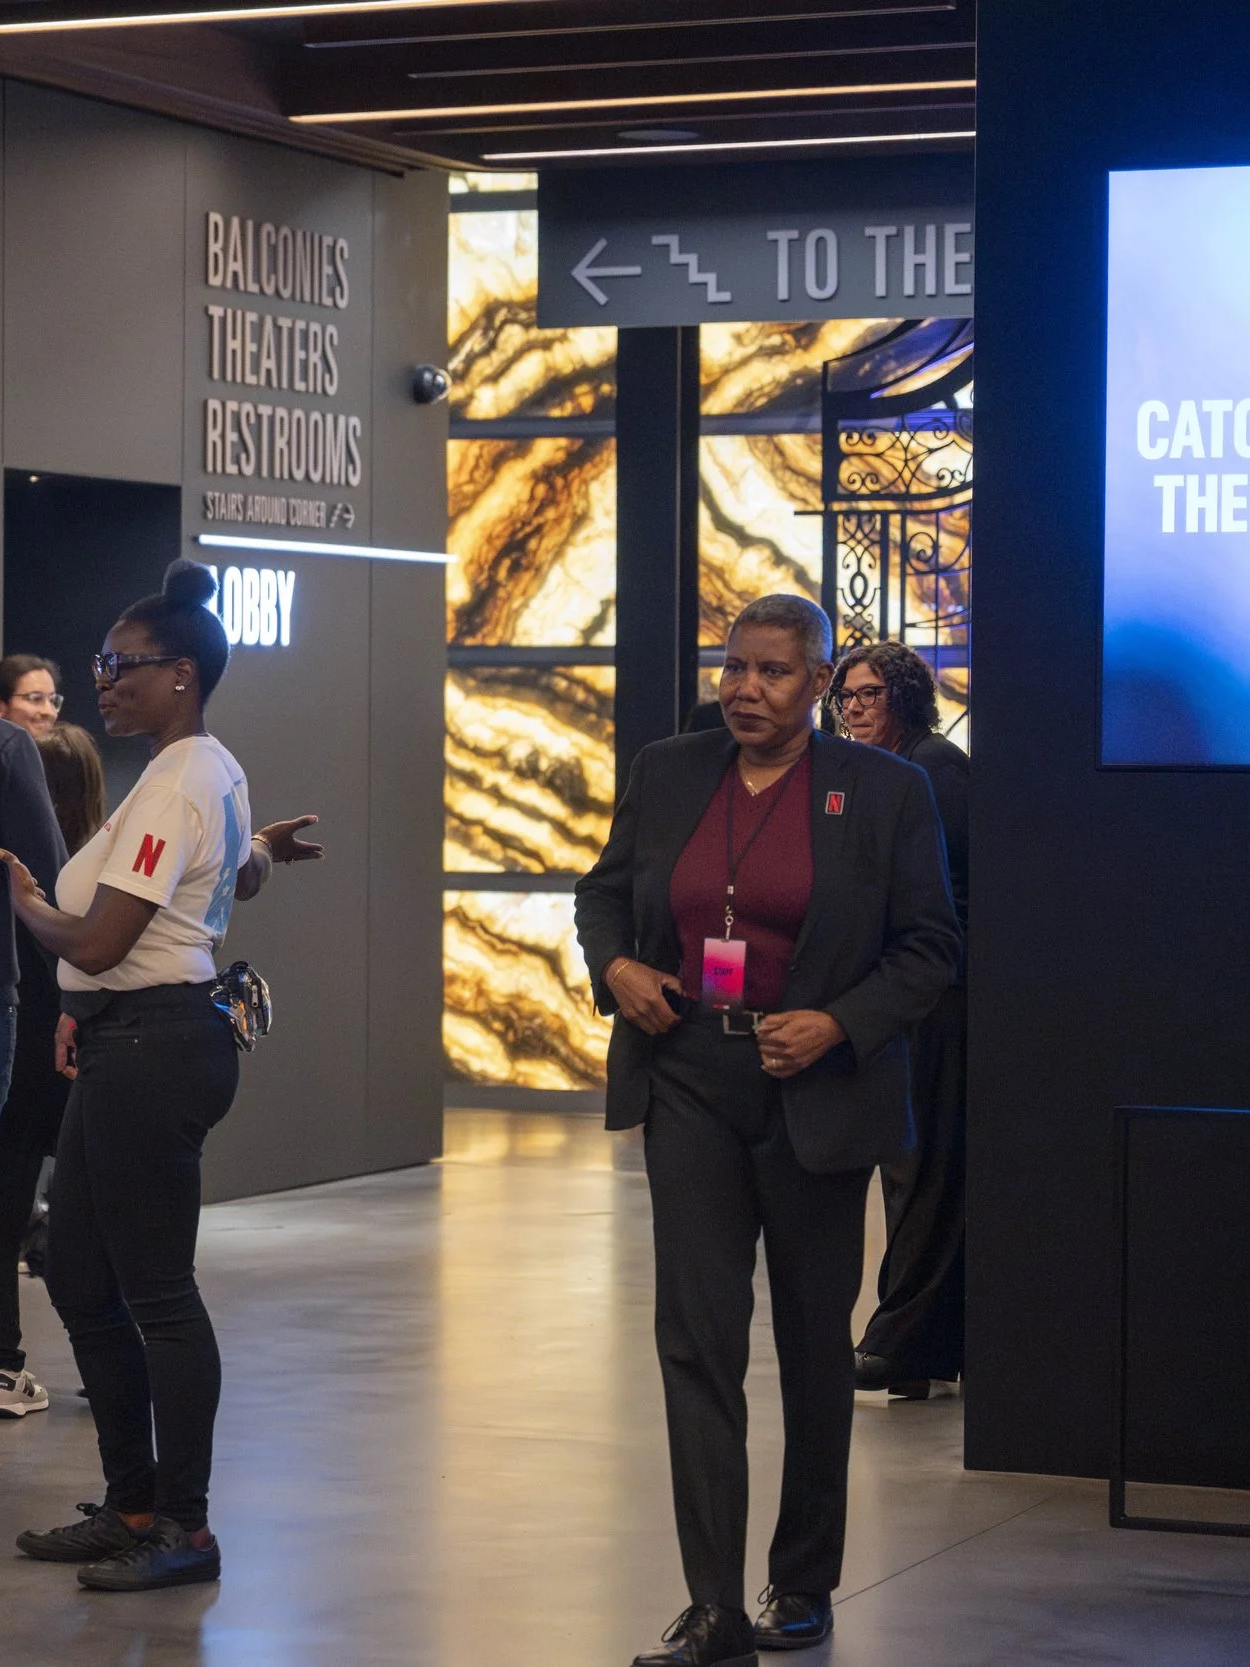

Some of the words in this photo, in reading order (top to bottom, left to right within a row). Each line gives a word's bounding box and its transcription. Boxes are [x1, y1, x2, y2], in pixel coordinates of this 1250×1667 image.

[207, 211, 350, 309] BALCONIES
[766, 228, 839, 300] TO
[864, 223, 972, 297] THE
[207, 305, 339, 396] THEATERS
[206, 399, 362, 487] RESTROOMS
[206, 491, 244, 522] STAIRS
[247, 495, 287, 525] AROUND
[289, 498, 327, 528] CORNER
[1153, 474, 1248, 533] THE
[828, 793, 842, 812] N
[132, 833, 166, 878] N
